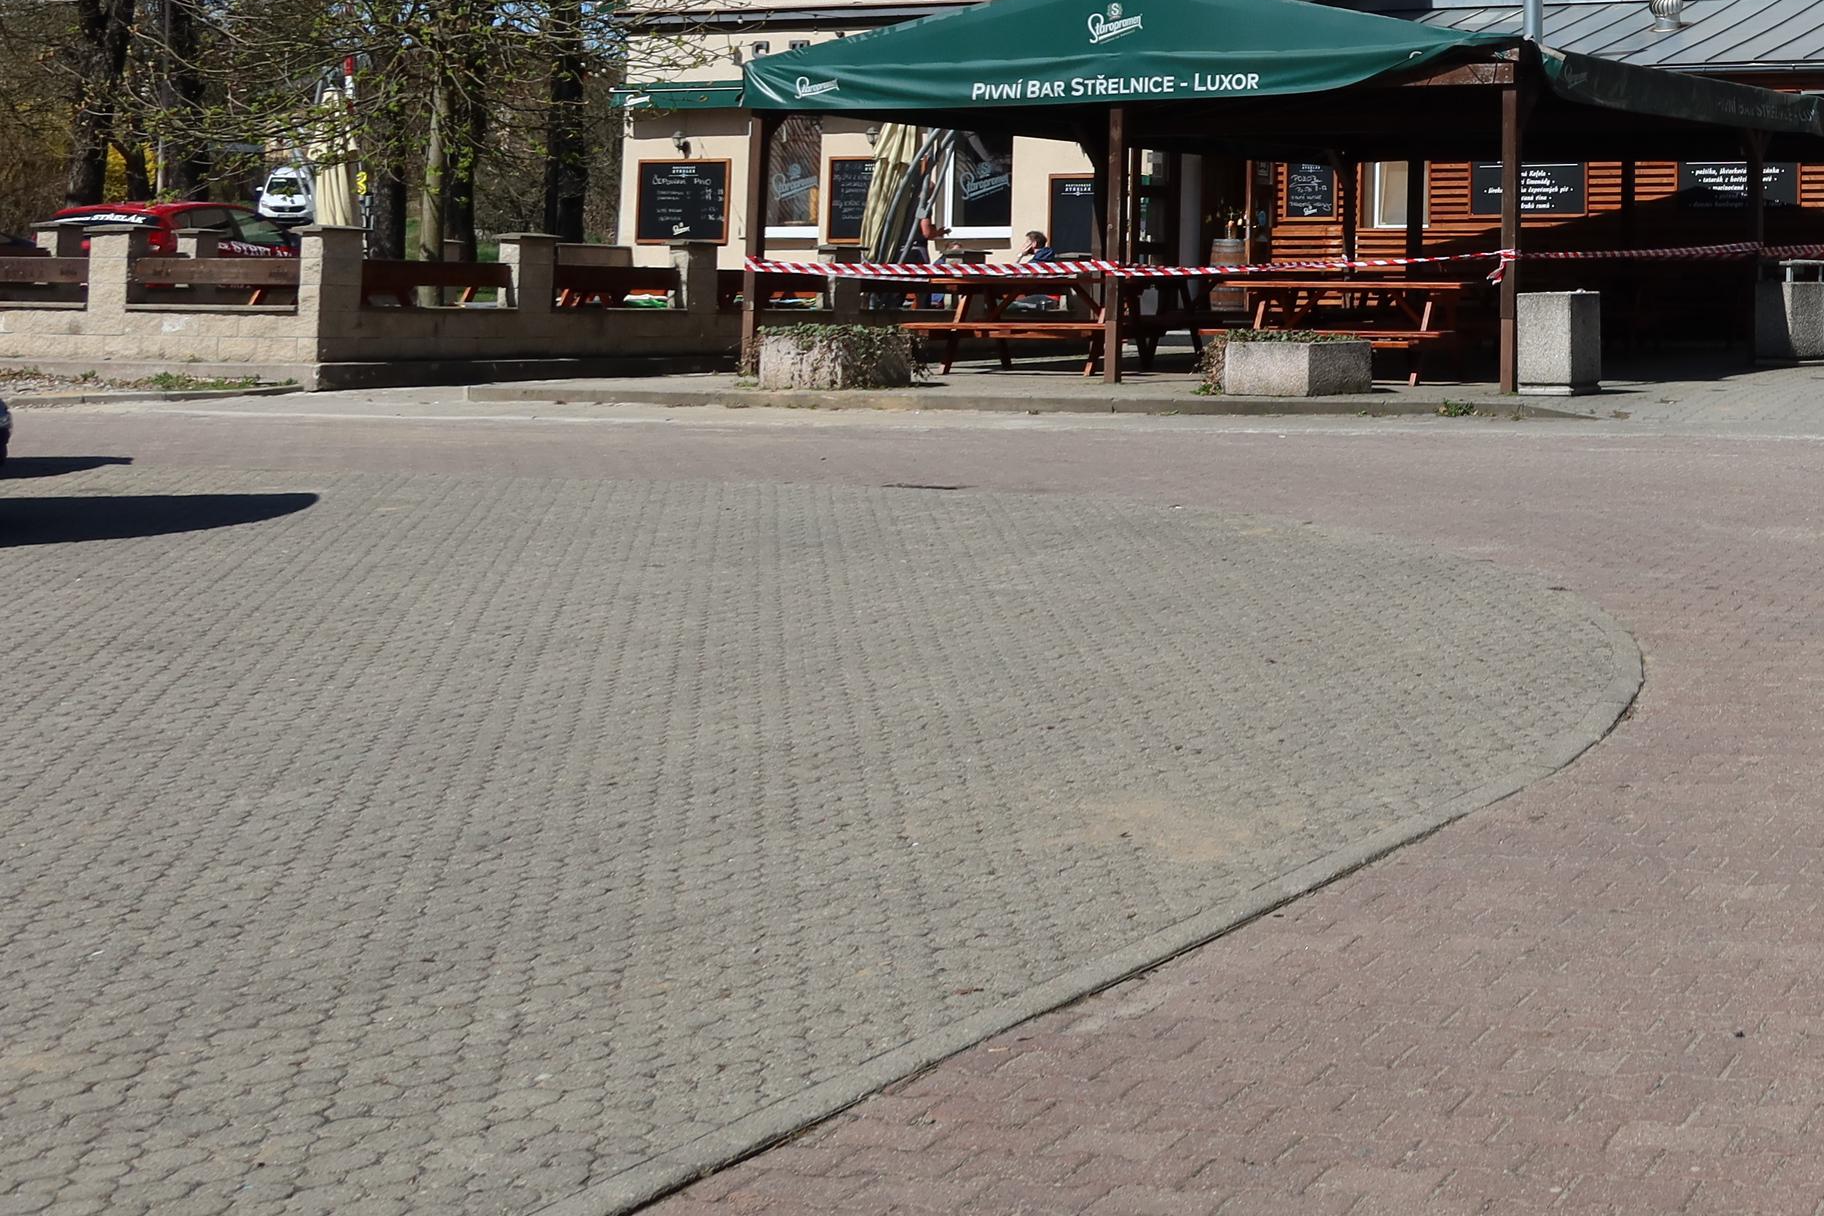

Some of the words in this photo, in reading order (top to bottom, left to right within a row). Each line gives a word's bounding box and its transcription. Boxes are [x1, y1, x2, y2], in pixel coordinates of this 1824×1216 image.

[1087, 13, 1143, 43] Staropramen
[971, 78, 1023, 101] PIVNÍ
[1026, 80, 1066, 99] BAR
[1071, 74, 1176, 97] STŘELNICE
[1194, 72, 1260, 92] LUXOR
